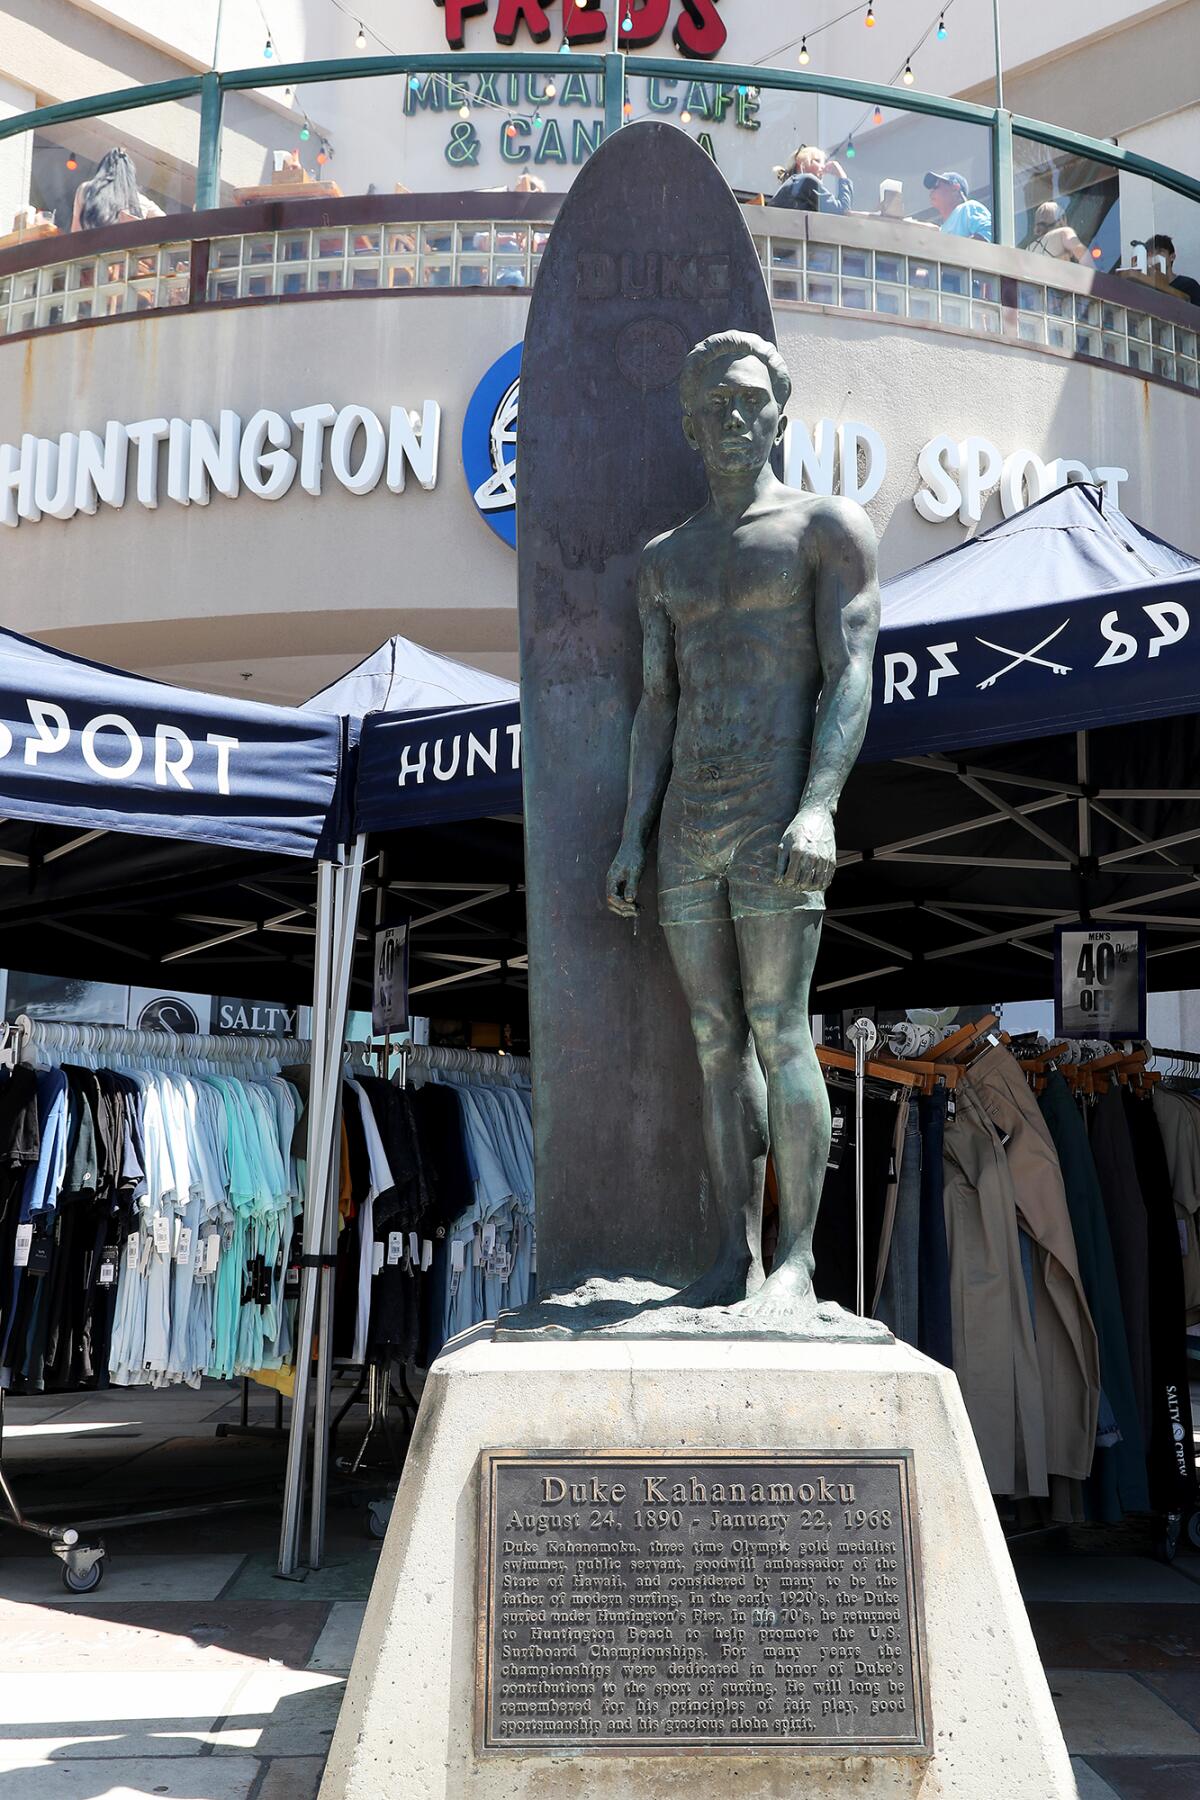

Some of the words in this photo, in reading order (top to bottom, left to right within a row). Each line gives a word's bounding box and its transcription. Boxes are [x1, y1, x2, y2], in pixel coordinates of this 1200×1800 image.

[444, 120, 480, 167] &
[575, 251, 729, 299] DUKE
[0, 400, 441, 527] HUNTINGTON
[784, 417, 887, 506] ND
[1088, 932, 1111, 941] MEN'S
[219, 1004, 298, 1032] SALTY
[1166, 1385, 1181, 1422] SALTY
[1175, 1442, 1188, 1476] CREW
[542, 1476, 626, 1502] Duke
[644, 1476, 856, 1503] Kahanamoku
[506, 1511, 580, 1531] August
[634, 1510, 683, 1528] 1890
[711, 1511, 790, 1531] January
[845, 1510, 892, 1528] 1968
[503, 1541, 538, 1552] Duke
[650, 1541, 684, 1552] three
[692, 1541, 724, 1552] time
[732, 1540, 790, 1553] Olympic
[800, 1540, 829, 1553] gold
[837, 1540, 895, 1552] medalist
[577, 1558, 621, 1572] public
[694, 1558, 755, 1573] goodwill
[765, 1558, 844, 1569] ambassador
[854, 1557, 868, 1569] of
[876, 1557, 897, 1569] the
[503, 1575, 539, 1587] State
[549, 1575, 563, 1587] of
[636, 1575, 660, 1587] and
[670, 1574, 745, 1587] considered
[754, 1574, 771, 1590] by
[781, 1576, 816, 1590] many
[827, 1576, 840, 1586] to
[850, 1574, 866, 1586] be
[877, 1574, 898, 1586] the
[503, 1592, 544, 1604] father
[551, 1592, 565, 1604] of
[571, 1592, 622, 1604] modern
[689, 1592, 704, 1604] In
[711, 1592, 730, 1603] the
[738, 1592, 772, 1607] early
[836, 1592, 857, 1603] the
[864, 1591, 899, 1603] Duke
[503, 1610, 545, 1622] surfed
[551, 1610, 590, 1622] under
[597, 1609, 686, 1625] Huntington's
[732, 1609, 746, 1621] In
[753, 1609, 775, 1621] his
[821, 1609, 836, 1621] he
[843, 1609, 900, 1621] returned
[503, 1629, 516, 1640] to
[531, 1627, 614, 1642] Huntington
[628, 1627, 672, 1640] Beach
[686, 1628, 700, 1639] to
[714, 1627, 745, 1641] help
[759, 1628, 819, 1641] promote
[833, 1627, 855, 1638] the
[503, 1645, 576, 1657] Surfboard
[721, 1644, 747, 1657] For
[764, 1646, 802, 1660] many
[821, 1646, 860, 1660] years
[878, 1644, 901, 1656] the
[502, 1663, 611, 1679] championships
[622, 1665, 657, 1676] were
[669, 1662, 738, 1675] dedicated
[751, 1662, 764, 1674] in
[776, 1662, 817, 1674] honor
[829, 1662, 844, 1674] of
[855, 1661, 903, 1674] Duke's
[502, 1681, 595, 1693] contributions
[603, 1682, 616, 1693] to
[625, 1681, 646, 1693] the
[655, 1682, 690, 1696] sport
[700, 1681, 715, 1692] of
[786, 1681, 805, 1692] He
[814, 1680, 841, 1692] will
[850, 1680, 880, 1694] long
[889, 1680, 905, 1691] be
[501, 1699, 591, 1712] remembered
[602, 1699, 625, 1712] for
[637, 1699, 658, 1711] his
[670, 1698, 745, 1714] principles
[758, 1699, 774, 1711] of
[784, 1698, 811, 1711] fair
[871, 1698, 905, 1713] good
[501, 1718, 601, 1736] sportsmanship
[607, 1717, 631, 1732] and
[638, 1717, 659, 1732] his
[665, 1717, 724, 1734] gracious
[731, 1717, 768, 1729] aloha
